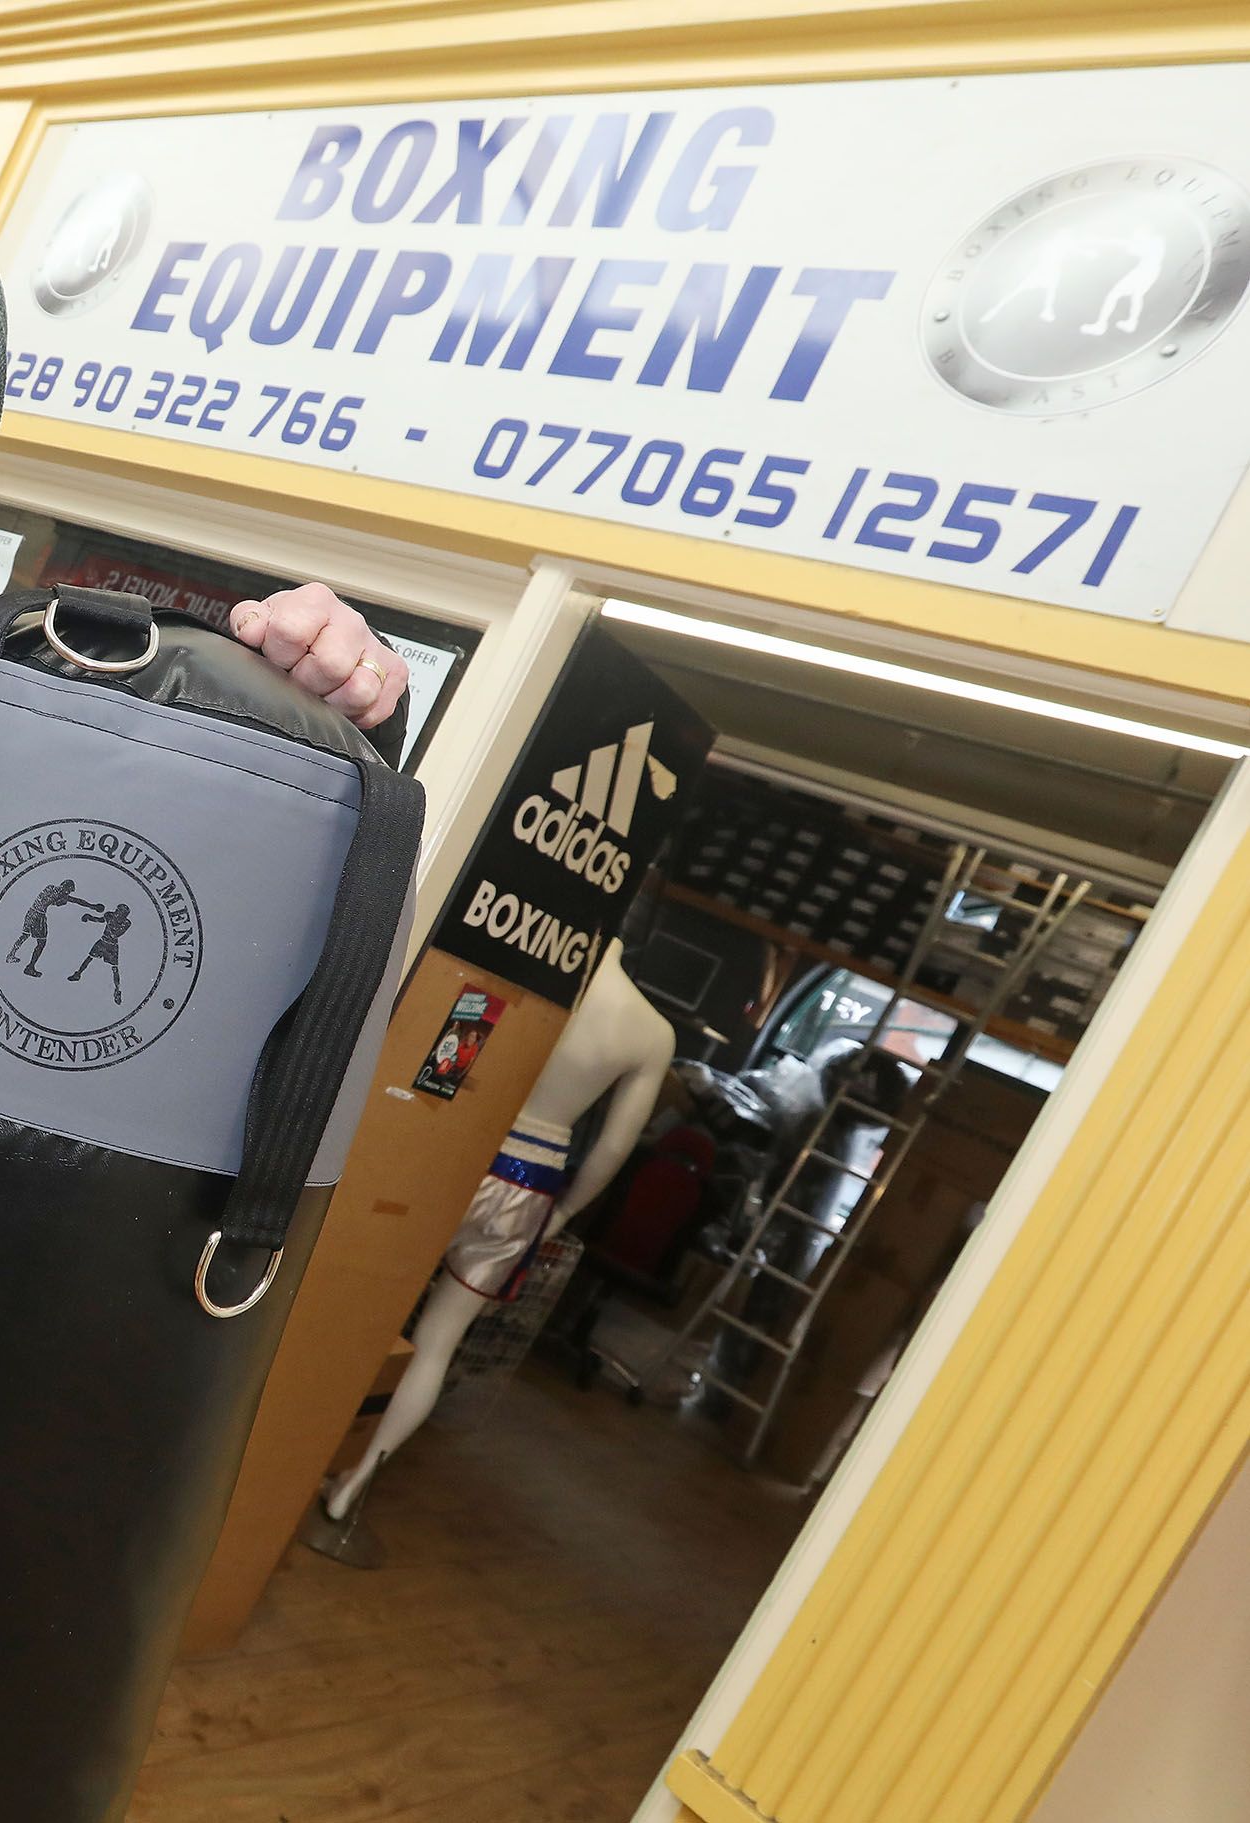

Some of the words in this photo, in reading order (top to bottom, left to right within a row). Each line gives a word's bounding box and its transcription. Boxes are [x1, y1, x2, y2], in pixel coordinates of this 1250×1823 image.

[274, 106, 775, 232] BOXING
[130, 241, 897, 402] EQUIPMENT
[5, 351, 64, 402] 28
[73, 361, 132, 413] 90
[134, 371, 240, 432] 322
[248, 385, 365, 451] 766
[473, 417, 812, 530] 077065
[822, 468, 1141, 587] 12571
[402, 647, 438, 666] OFFER
[76, 829, 195, 968] EQUIPMENT
[513, 794, 631, 894] adidas
[463, 879, 590, 973] BOXING
